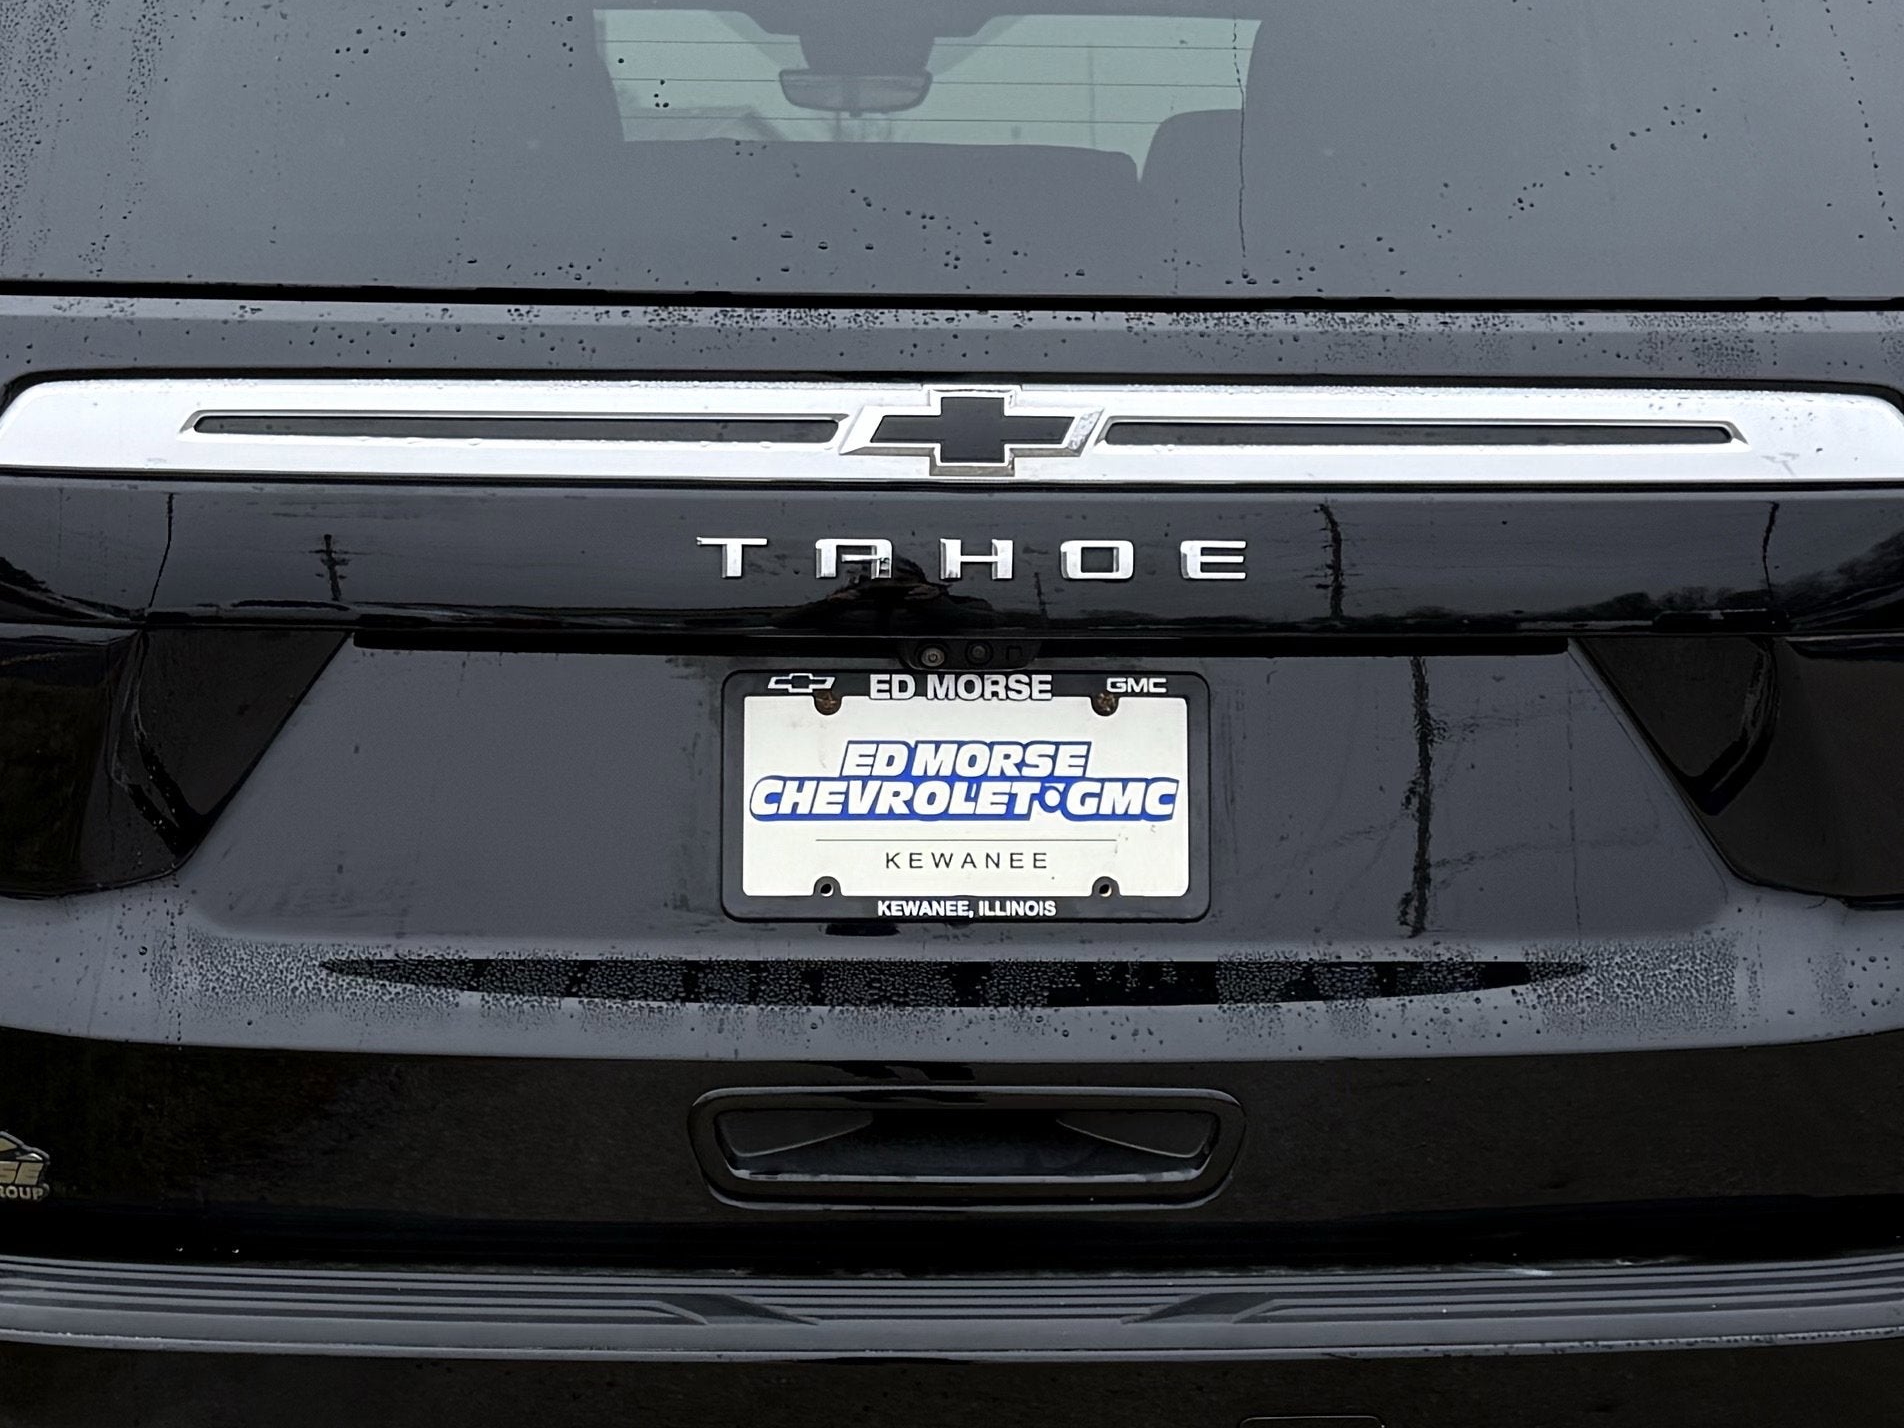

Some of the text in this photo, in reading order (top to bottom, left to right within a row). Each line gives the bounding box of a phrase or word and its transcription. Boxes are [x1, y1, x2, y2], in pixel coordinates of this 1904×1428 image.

[696, 538, 1247, 580] TAHOE
[869, 674, 1053, 701] ED MORSE
[1106, 677, 1167, 693] GMC
[841, 742, 1090, 778] ED MORSE
[885, 852, 1048, 869] KEWANEE
[877, 900, 1057, 918] KEWANEE, ILLINOIS
